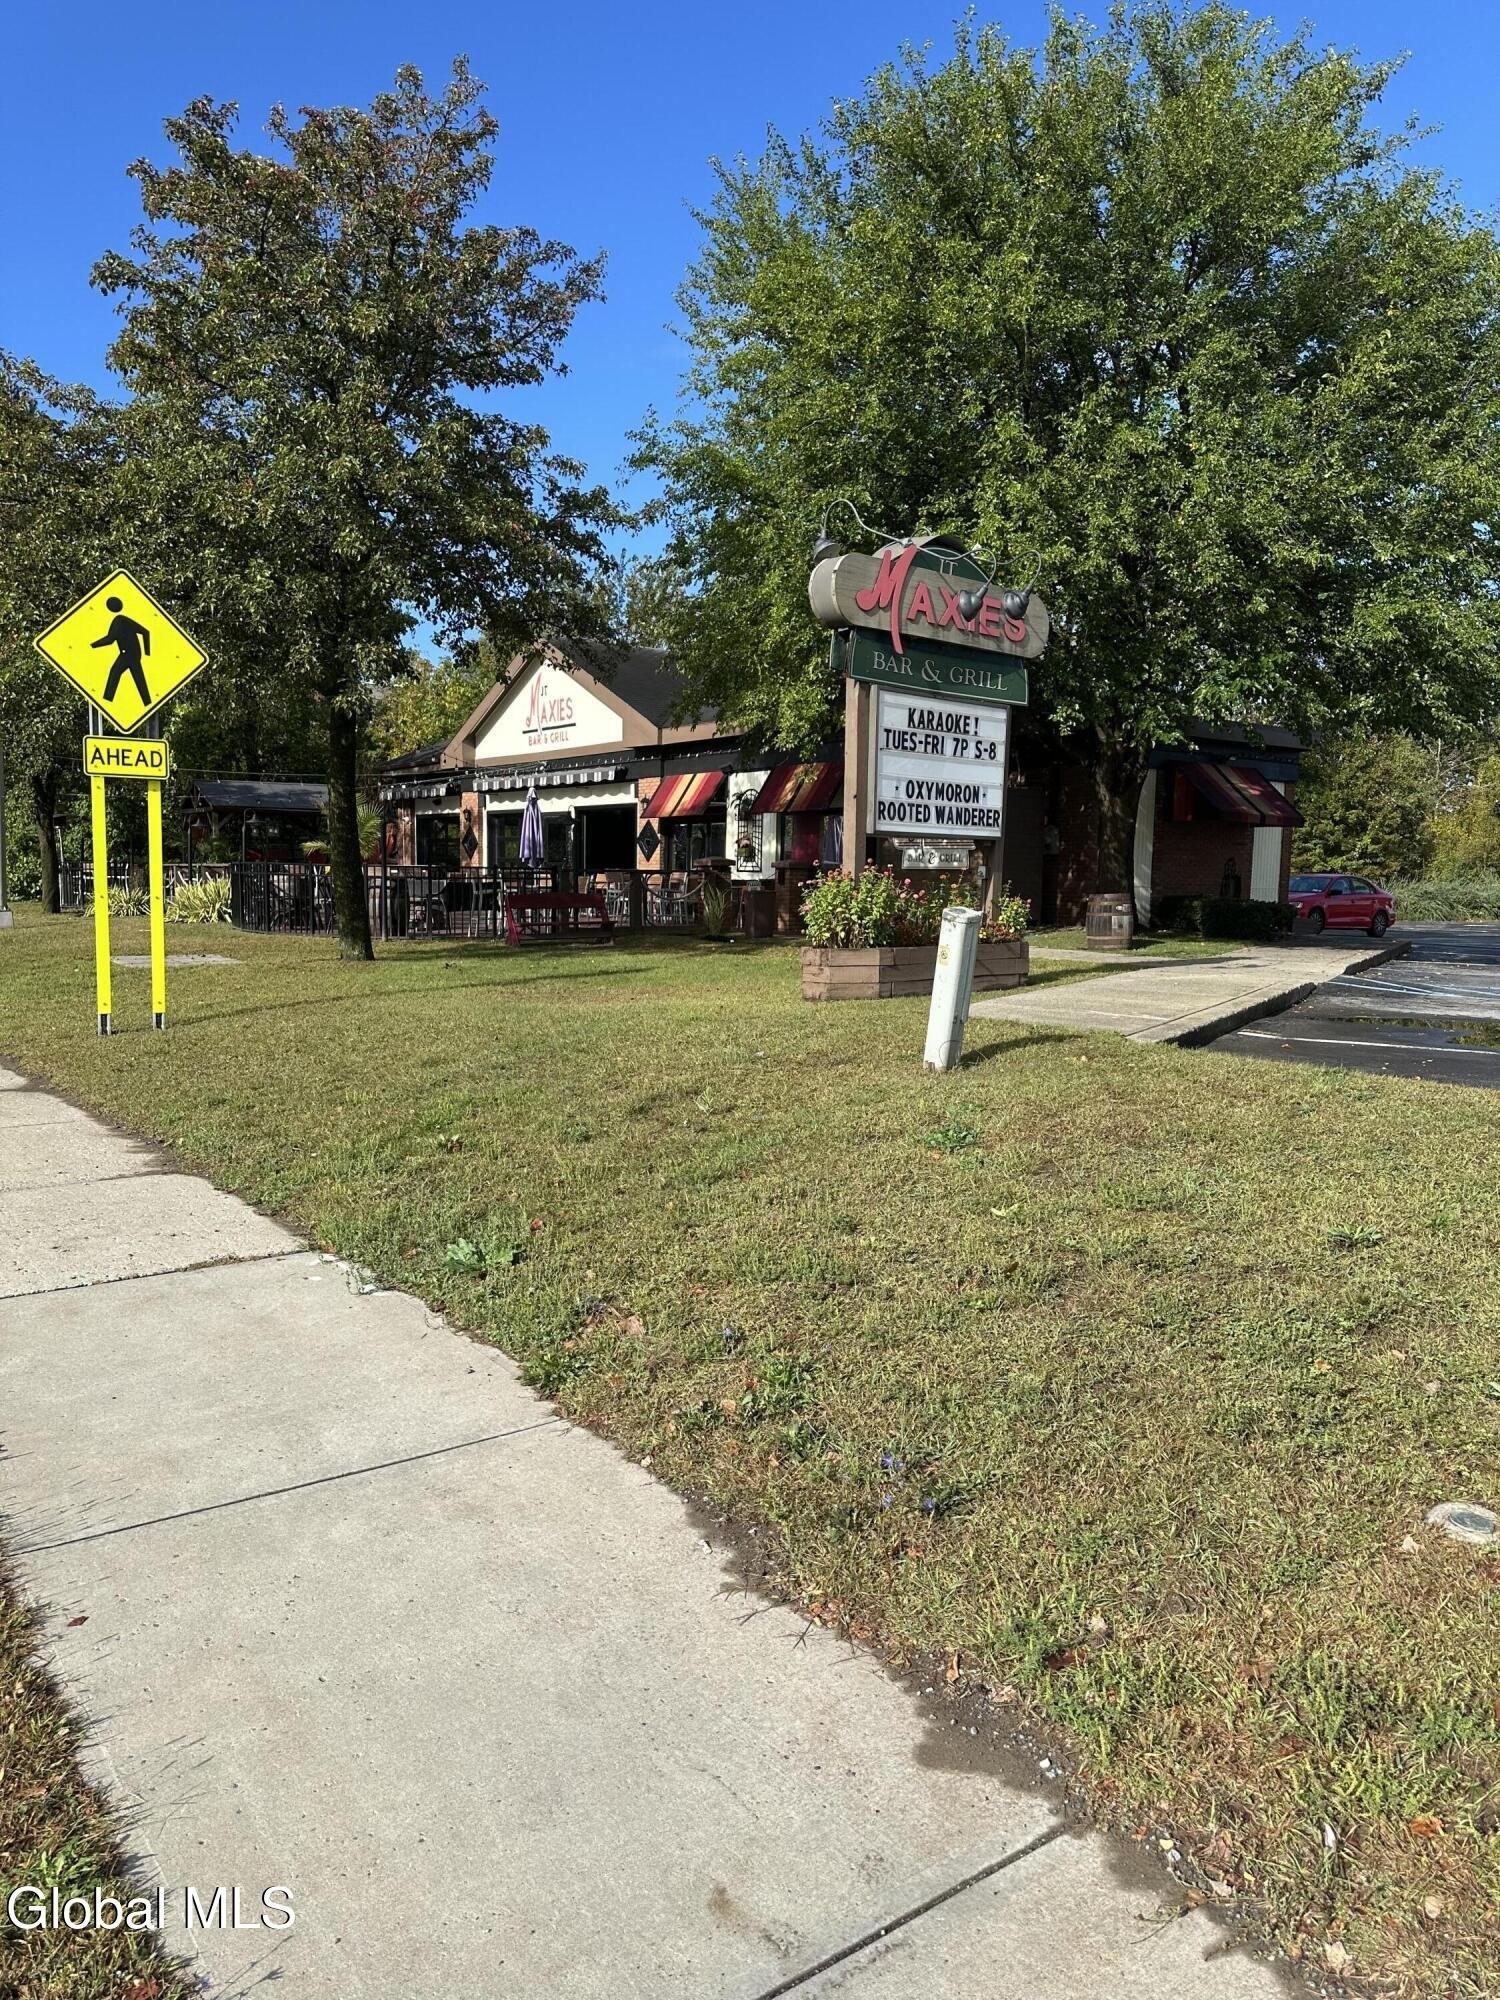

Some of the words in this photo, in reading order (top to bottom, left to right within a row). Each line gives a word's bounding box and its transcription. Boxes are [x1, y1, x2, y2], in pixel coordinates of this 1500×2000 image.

[872, 651, 913, 676] BAR
[921, 659, 943, 683] &
[950, 666, 1008, 691] GRILL
[528, 734, 542, 746] BAR
[550, 731, 569, 743] GRILL
[883, 728, 945, 756] TUES-FRI
[952, 738, 968, 758] 7P
[90, 746, 163, 768] AHEAD
[905, 779, 980, 804] OXYMORON
[878, 801, 931, 823] ROOTED
[935, 805, 1001, 828] WANDERER
